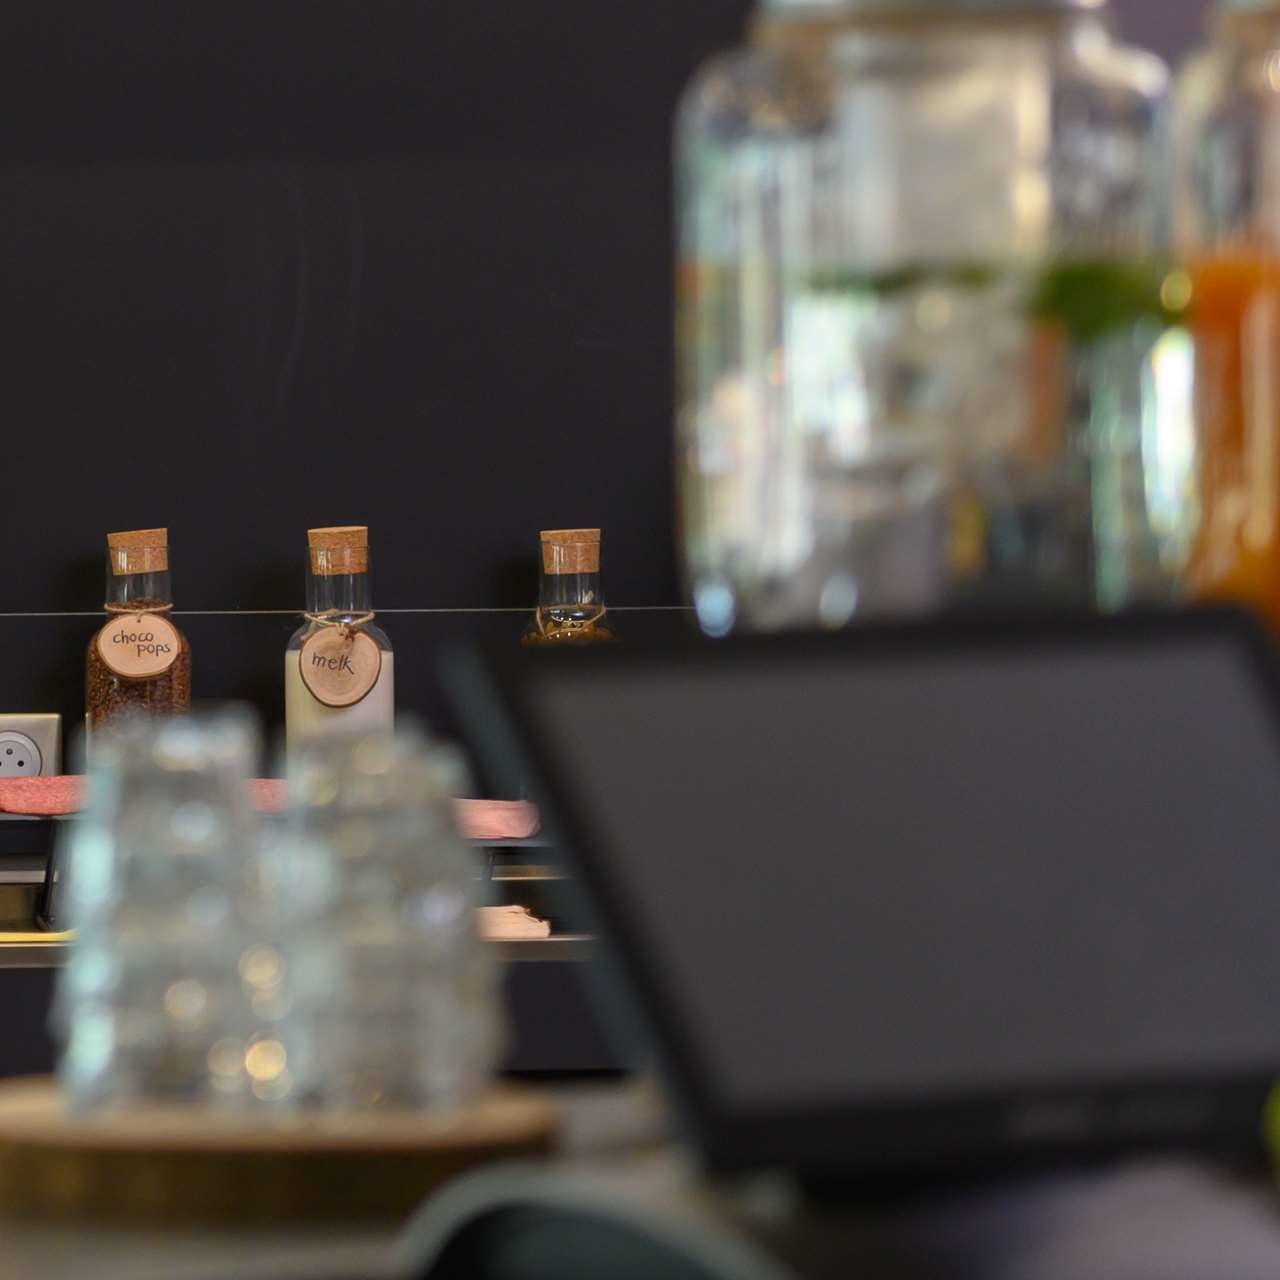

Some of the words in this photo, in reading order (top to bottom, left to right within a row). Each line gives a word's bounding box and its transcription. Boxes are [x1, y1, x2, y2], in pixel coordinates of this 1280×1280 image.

[113, 630, 153, 644] choco
[137, 644, 170, 657] pops
[312, 652, 354, 674] melk
